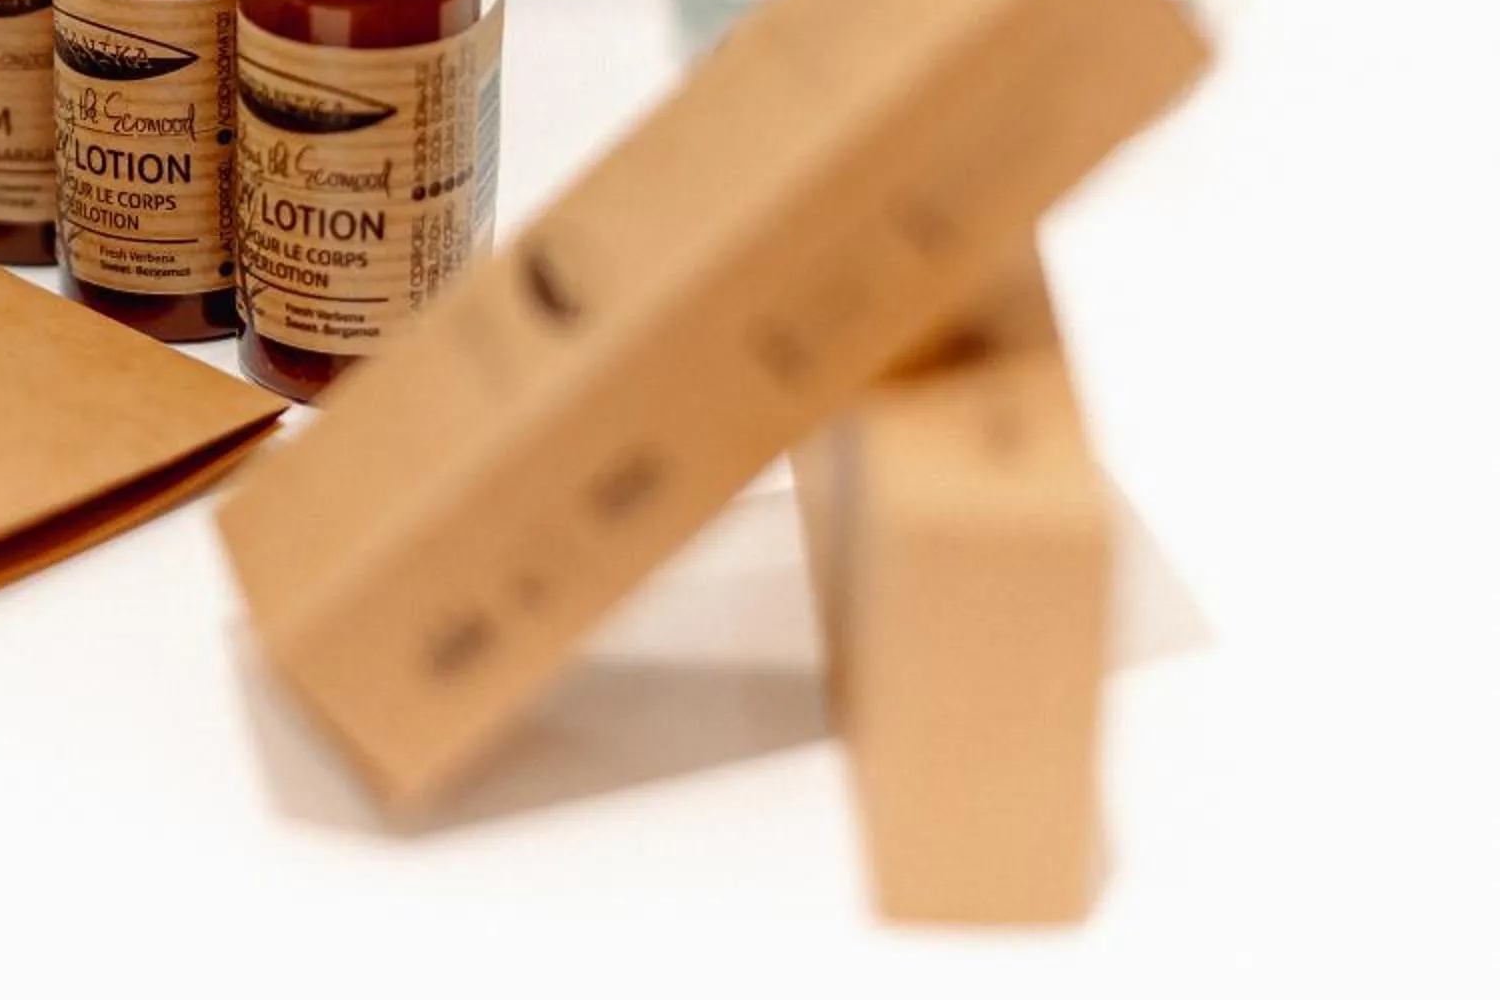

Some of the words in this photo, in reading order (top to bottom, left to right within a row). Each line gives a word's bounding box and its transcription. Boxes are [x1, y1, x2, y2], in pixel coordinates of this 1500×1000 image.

[75, 139, 192, 185] LOTION
[96, 186, 115, 205] LE
[116, 190, 178, 212] CORPS
[262, 192, 386, 242] LOTION
[284, 241, 302, 262] LE
[306, 247, 368, 269] CORPS
